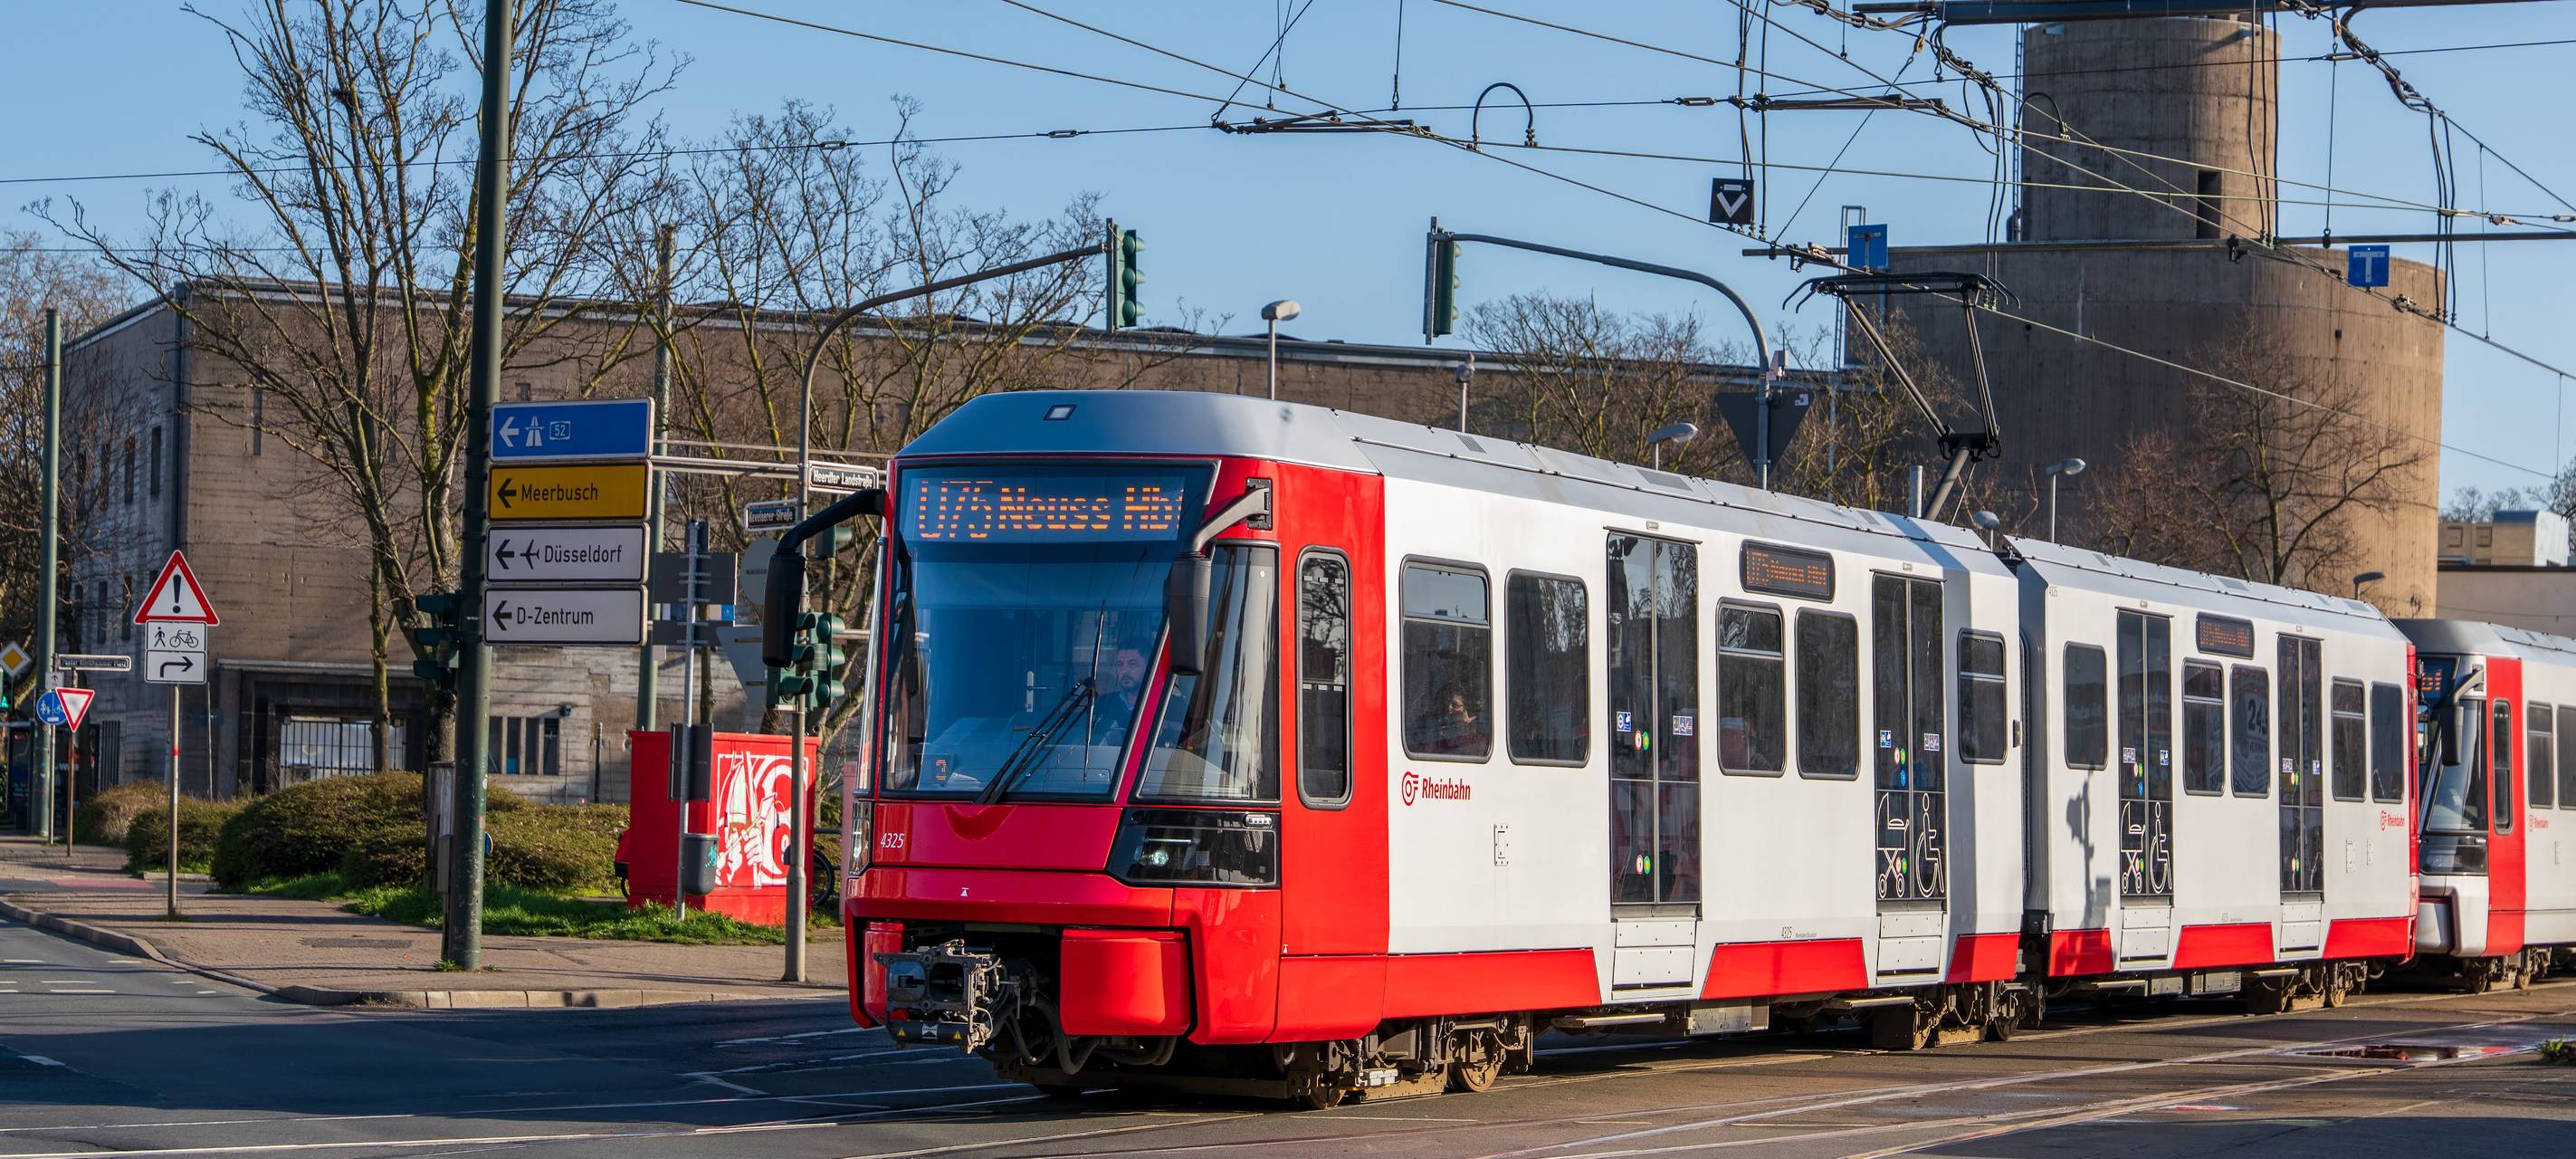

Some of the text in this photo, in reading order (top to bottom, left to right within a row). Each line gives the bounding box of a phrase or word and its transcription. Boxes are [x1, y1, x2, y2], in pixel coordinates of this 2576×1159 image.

[554, 425, 566, 436] 52
[841, 472, 873, 488] Landstraße
[521, 483, 598, 502] Meerbusch
[776, 507, 793, 522] Straße
[919, 481, 993, 538] U75
[998, 487, 1110, 530] Neuss
[544, 544, 622, 563] Düsseldorf
[1770, 560, 1804, 582] Neuss
[1808, 565, 1827, 585] Hbf
[517, 607, 594, 625] D-Zentrum
[1422, 777, 1471, 800] Rheinbahn
[880, 832, 905, 848] 4325
[1781, 925, 1792, 939] 4325
